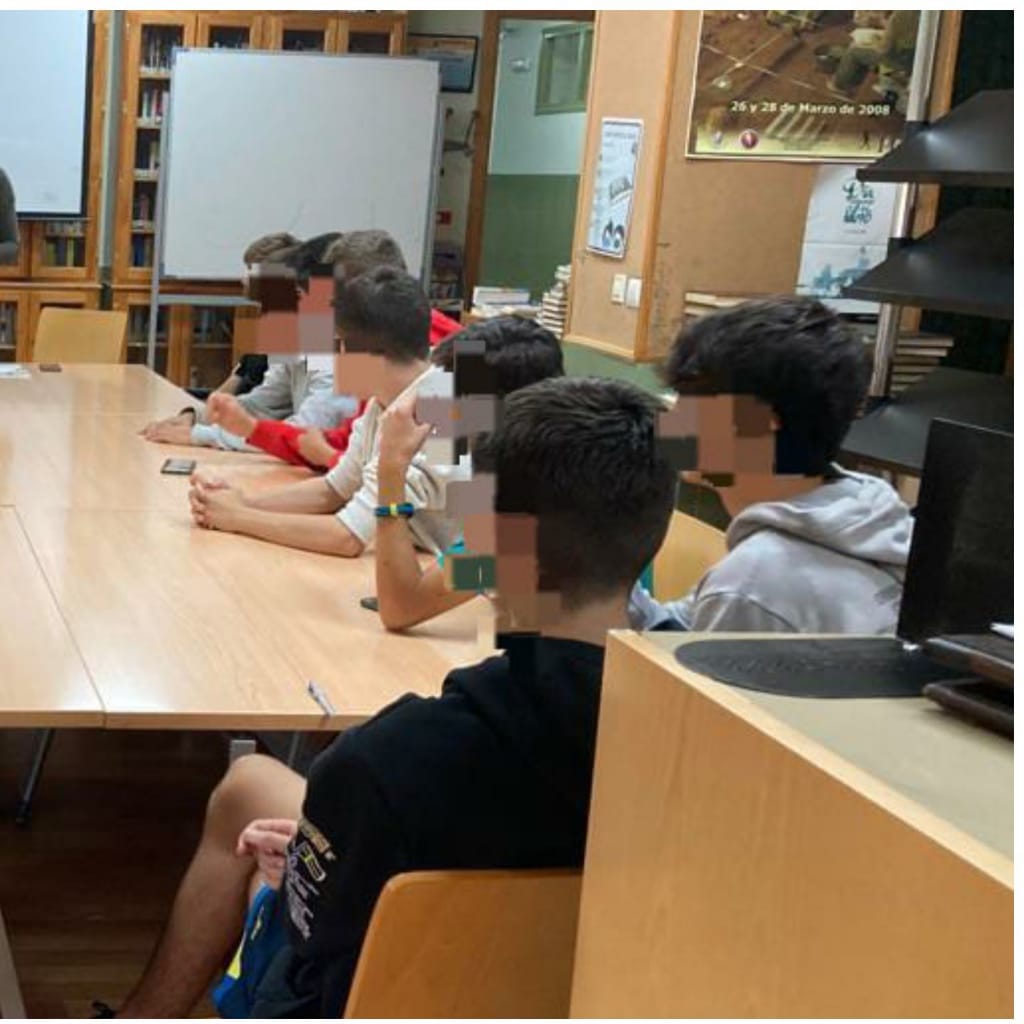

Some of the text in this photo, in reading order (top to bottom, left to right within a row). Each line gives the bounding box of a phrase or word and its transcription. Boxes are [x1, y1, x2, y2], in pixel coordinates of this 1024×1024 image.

[731, 101, 891, 115] 26 y 28 de Marzo de 2008
